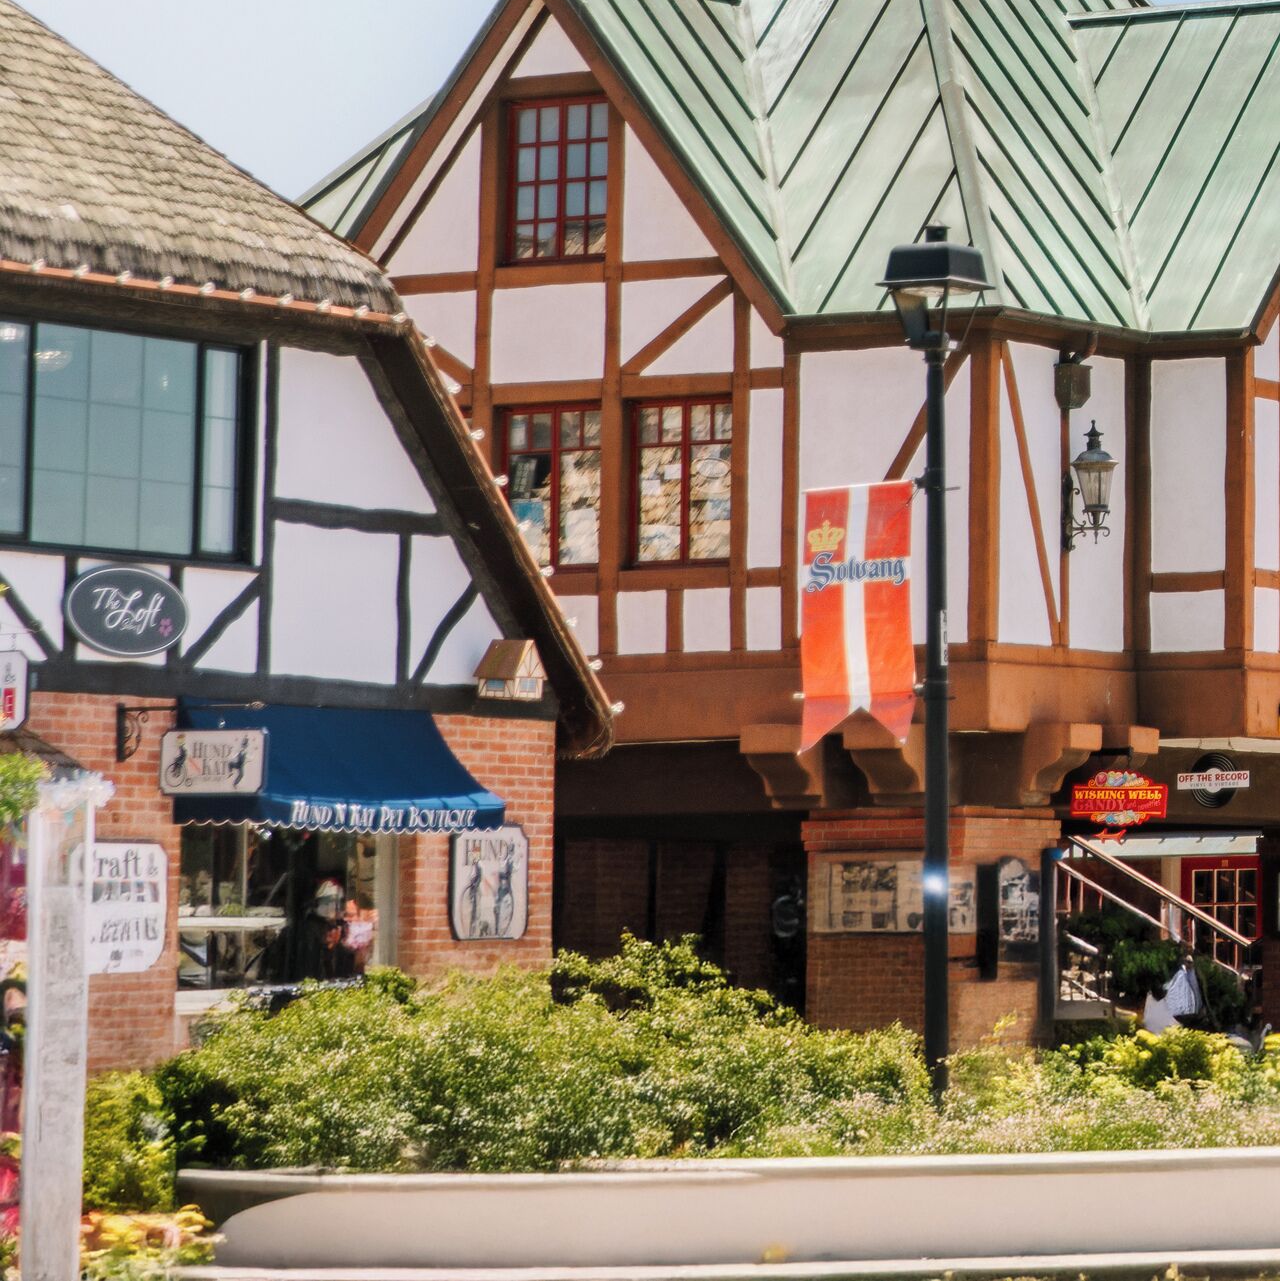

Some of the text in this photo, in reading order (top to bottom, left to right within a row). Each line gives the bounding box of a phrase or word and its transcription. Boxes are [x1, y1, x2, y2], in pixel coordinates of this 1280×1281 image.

[806, 551, 907, 593] Solvang
[92, 587, 121, 610] The
[105, 590, 165, 635] Loft
[191, 741, 233, 759] HUND
[1178, 773, 1248, 783] OFF THE RECORD
[1074, 790, 1162, 799] WISHING WELL
[292, 800, 478, 827] HUND N KAT PET BOUTIQUE
[1074, 800, 1127, 811] CANDY
